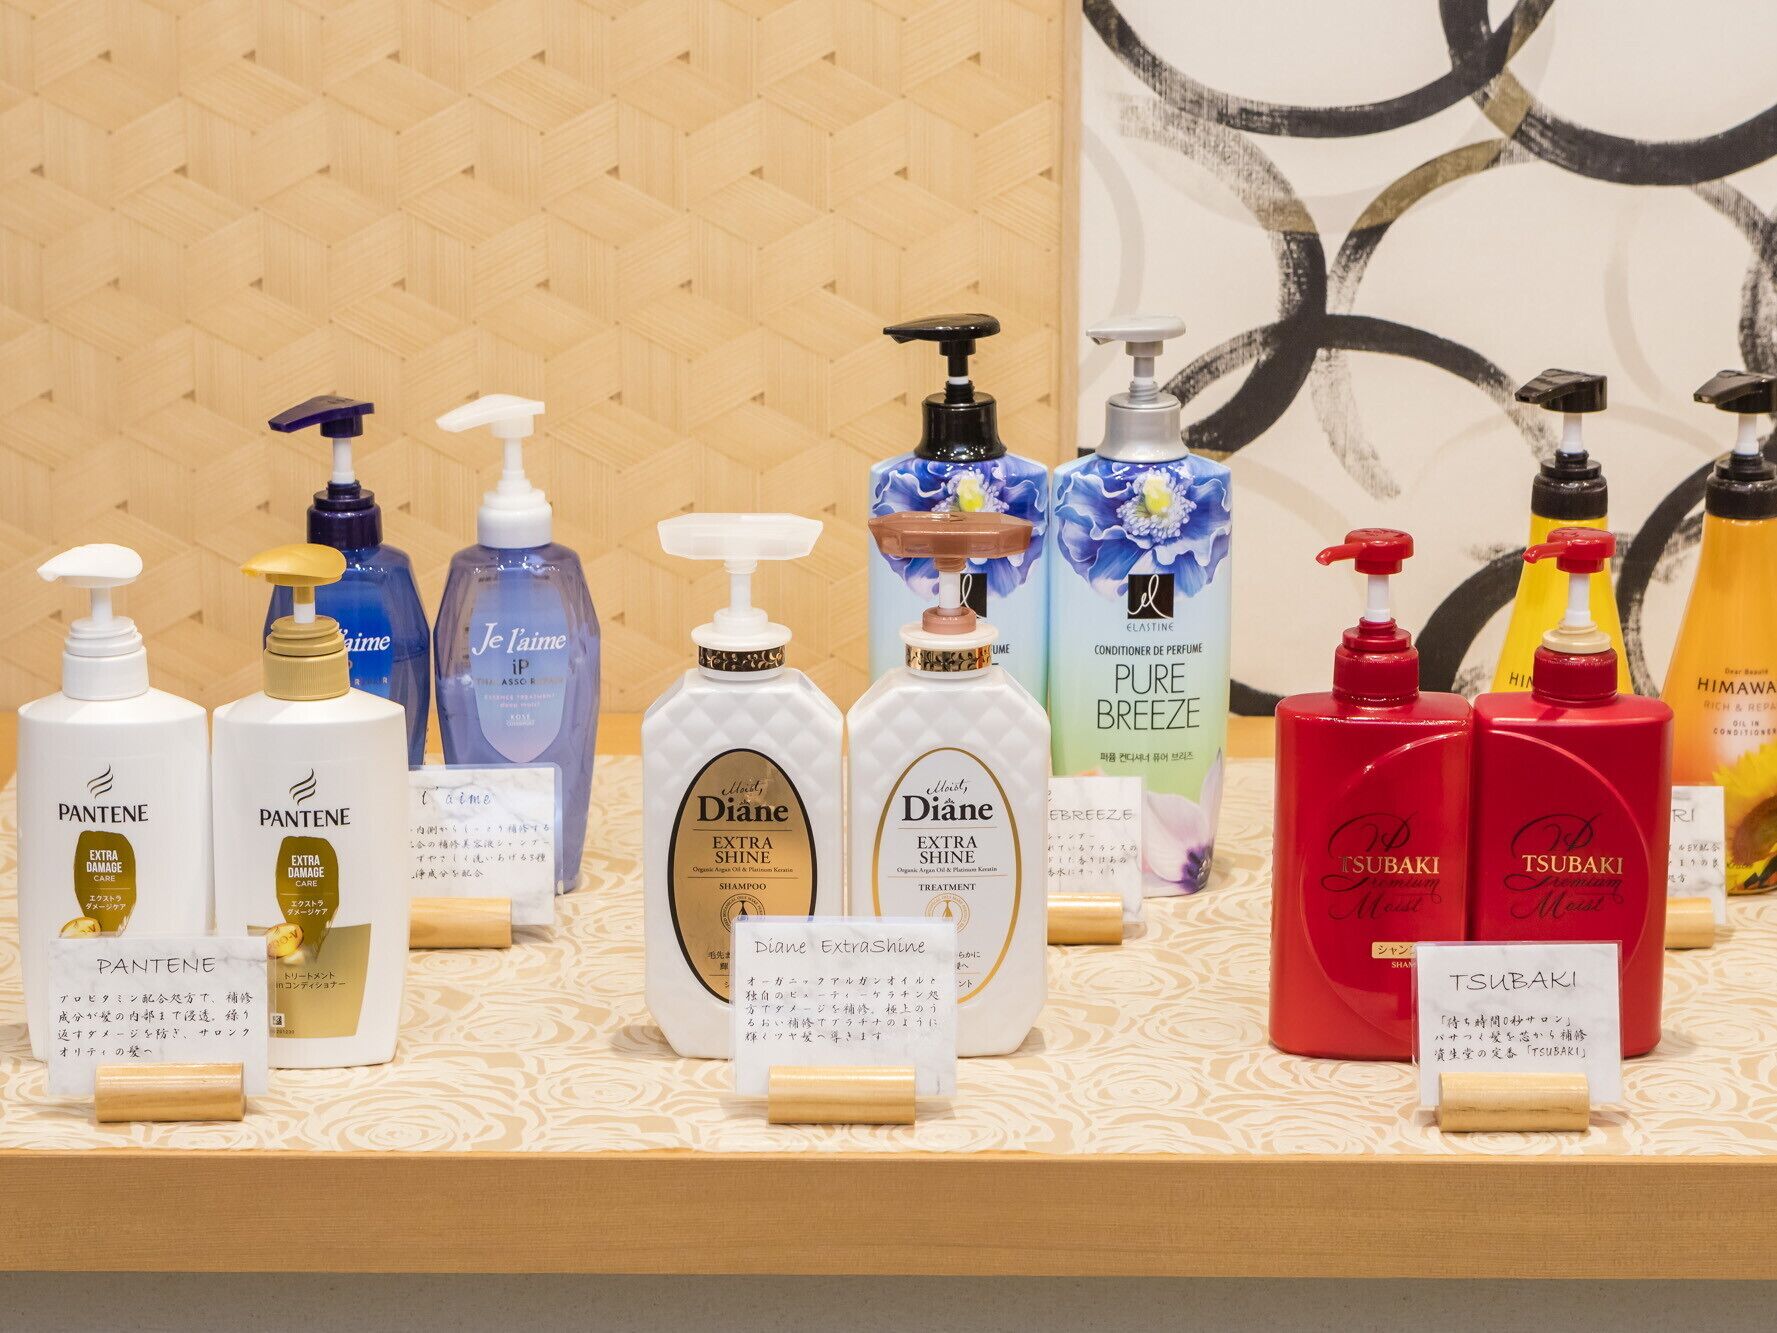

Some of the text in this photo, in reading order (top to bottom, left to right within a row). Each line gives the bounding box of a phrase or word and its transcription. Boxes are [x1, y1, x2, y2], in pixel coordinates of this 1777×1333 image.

[1126, 622, 1174, 632] ELASTINE
[339, 628, 391, 652] 'aime
[471, 622, 568, 656] Je l'aime
[1094, 643, 1203, 656] CONDITIONER DE PERFUME
[1115, 662, 1185, 695] PURE
[1704, 700, 1730, 712] RICH
[1735, 703, 1742, 712] &
[1097, 697, 1200, 731] BREEZE
[1713, 728, 1777, 736] CONDITIONER
[1171, 751, 1194, 762] 브리즈
[58, 803, 149, 824] PANTENE
[259, 807, 351, 828] PANTENE
[712, 836, 773, 849] EXTRA
[917, 836, 978, 849] EXTRA
[89, 849, 118, 861] EXTRA
[291, 854, 320, 866] EXTRA
[715, 850, 771, 864] SHINE
[919, 850, 976, 864] SHINE
[86, 861, 123, 873] DAMAGE
[692, 866, 714, 874] Organic
[714, 866, 732, 874] Argan
[1338, 856, 1440, 874] TSUBAKI
[1521, 854, 1624, 875] TSUBAKI
[287, 866, 325, 878] DAMAGE
[411, 869, 484, 879] 浄成分を配合
[896, 867, 918, 875] Organic
[718, 883, 767, 891] SHAMPOO
[918, 883, 977, 891] TREATMENT
[89, 894, 122, 902] エクストラ
[291, 899, 324, 907] エクストラ
[85, 902, 127, 911] ダメージケア
[287, 908, 328, 916] ダメージケア
[755, 937, 926, 955] Diane ExtraShine
[96, 957, 216, 975] PANTENE
[284, 971, 336, 980] トリートメント
[1449, 970, 1577, 992] TSUBAKI
